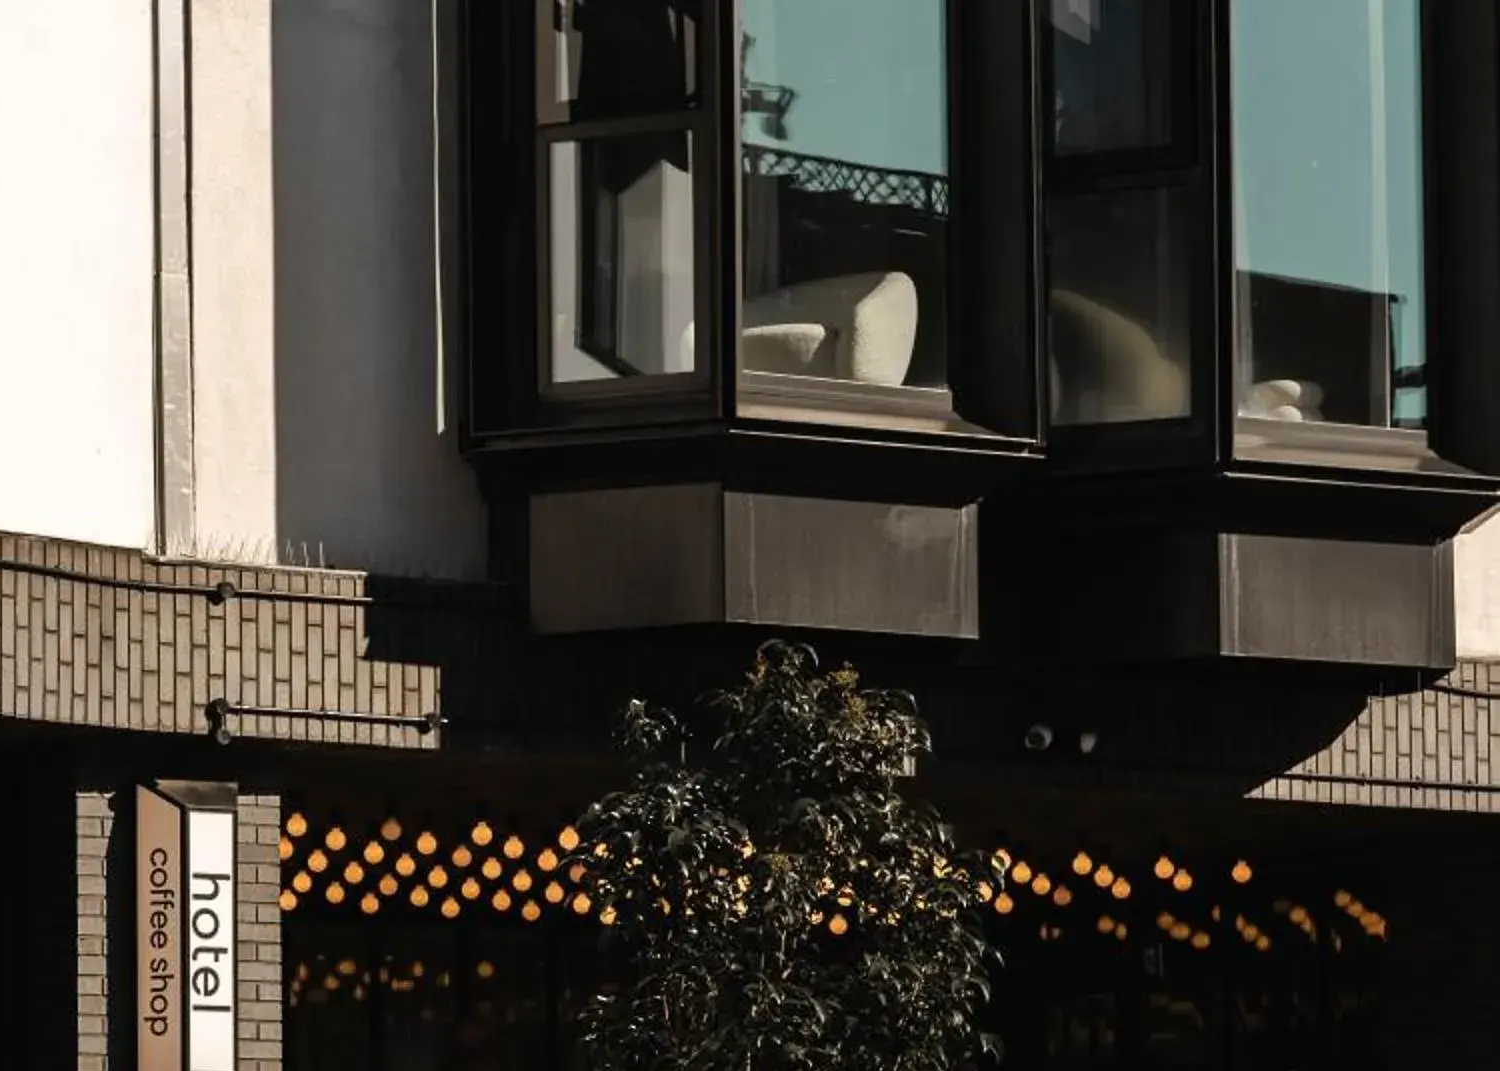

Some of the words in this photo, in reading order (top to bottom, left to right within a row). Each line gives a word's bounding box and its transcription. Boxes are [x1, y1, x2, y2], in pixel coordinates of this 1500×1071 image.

[149, 847, 175, 949] coffee
[191, 872, 231, 1013] hotel
[143, 958, 175, 1036] shop
